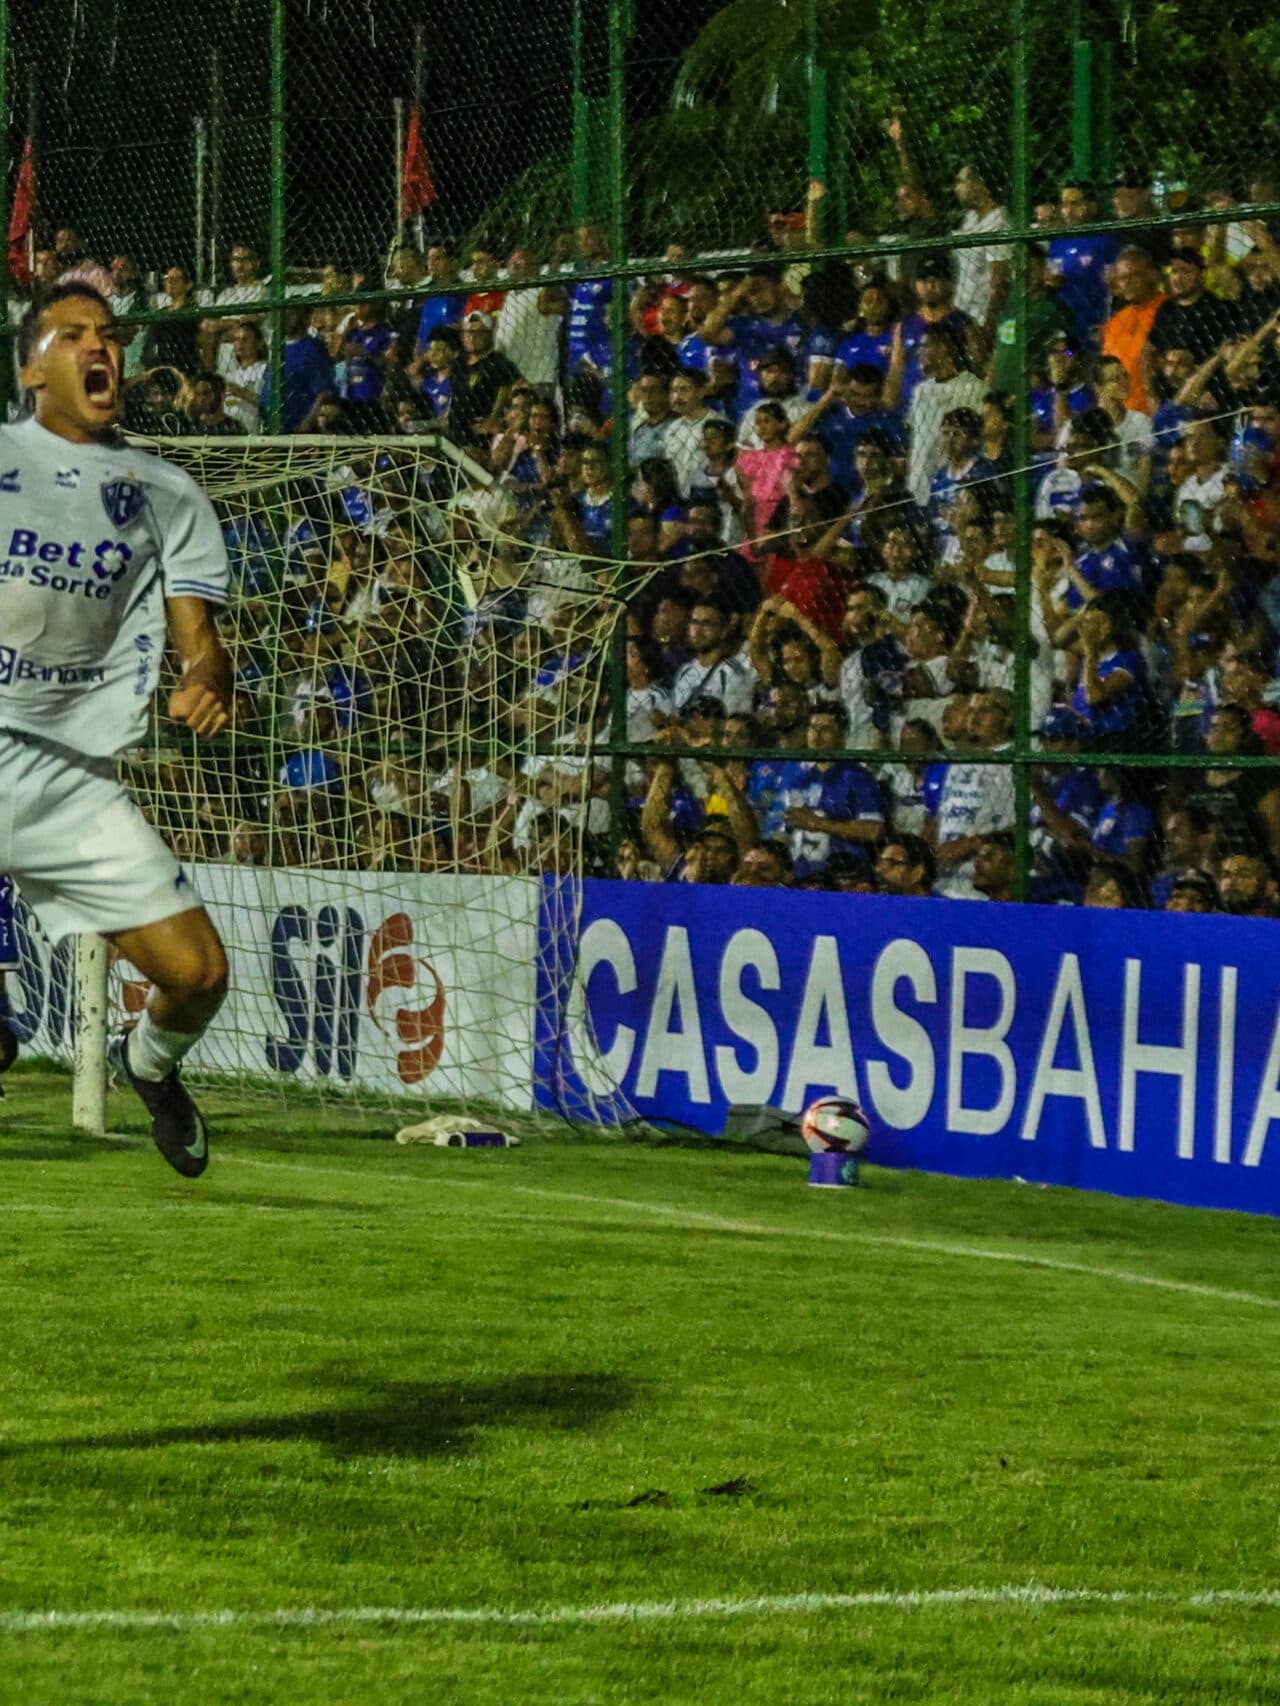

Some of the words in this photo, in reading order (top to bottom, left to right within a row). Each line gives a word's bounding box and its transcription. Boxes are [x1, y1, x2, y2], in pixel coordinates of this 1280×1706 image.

[8, 528, 86, 568] Bet
[29, 565, 111, 600] Sorte
[266, 904, 364, 1082] Sil
